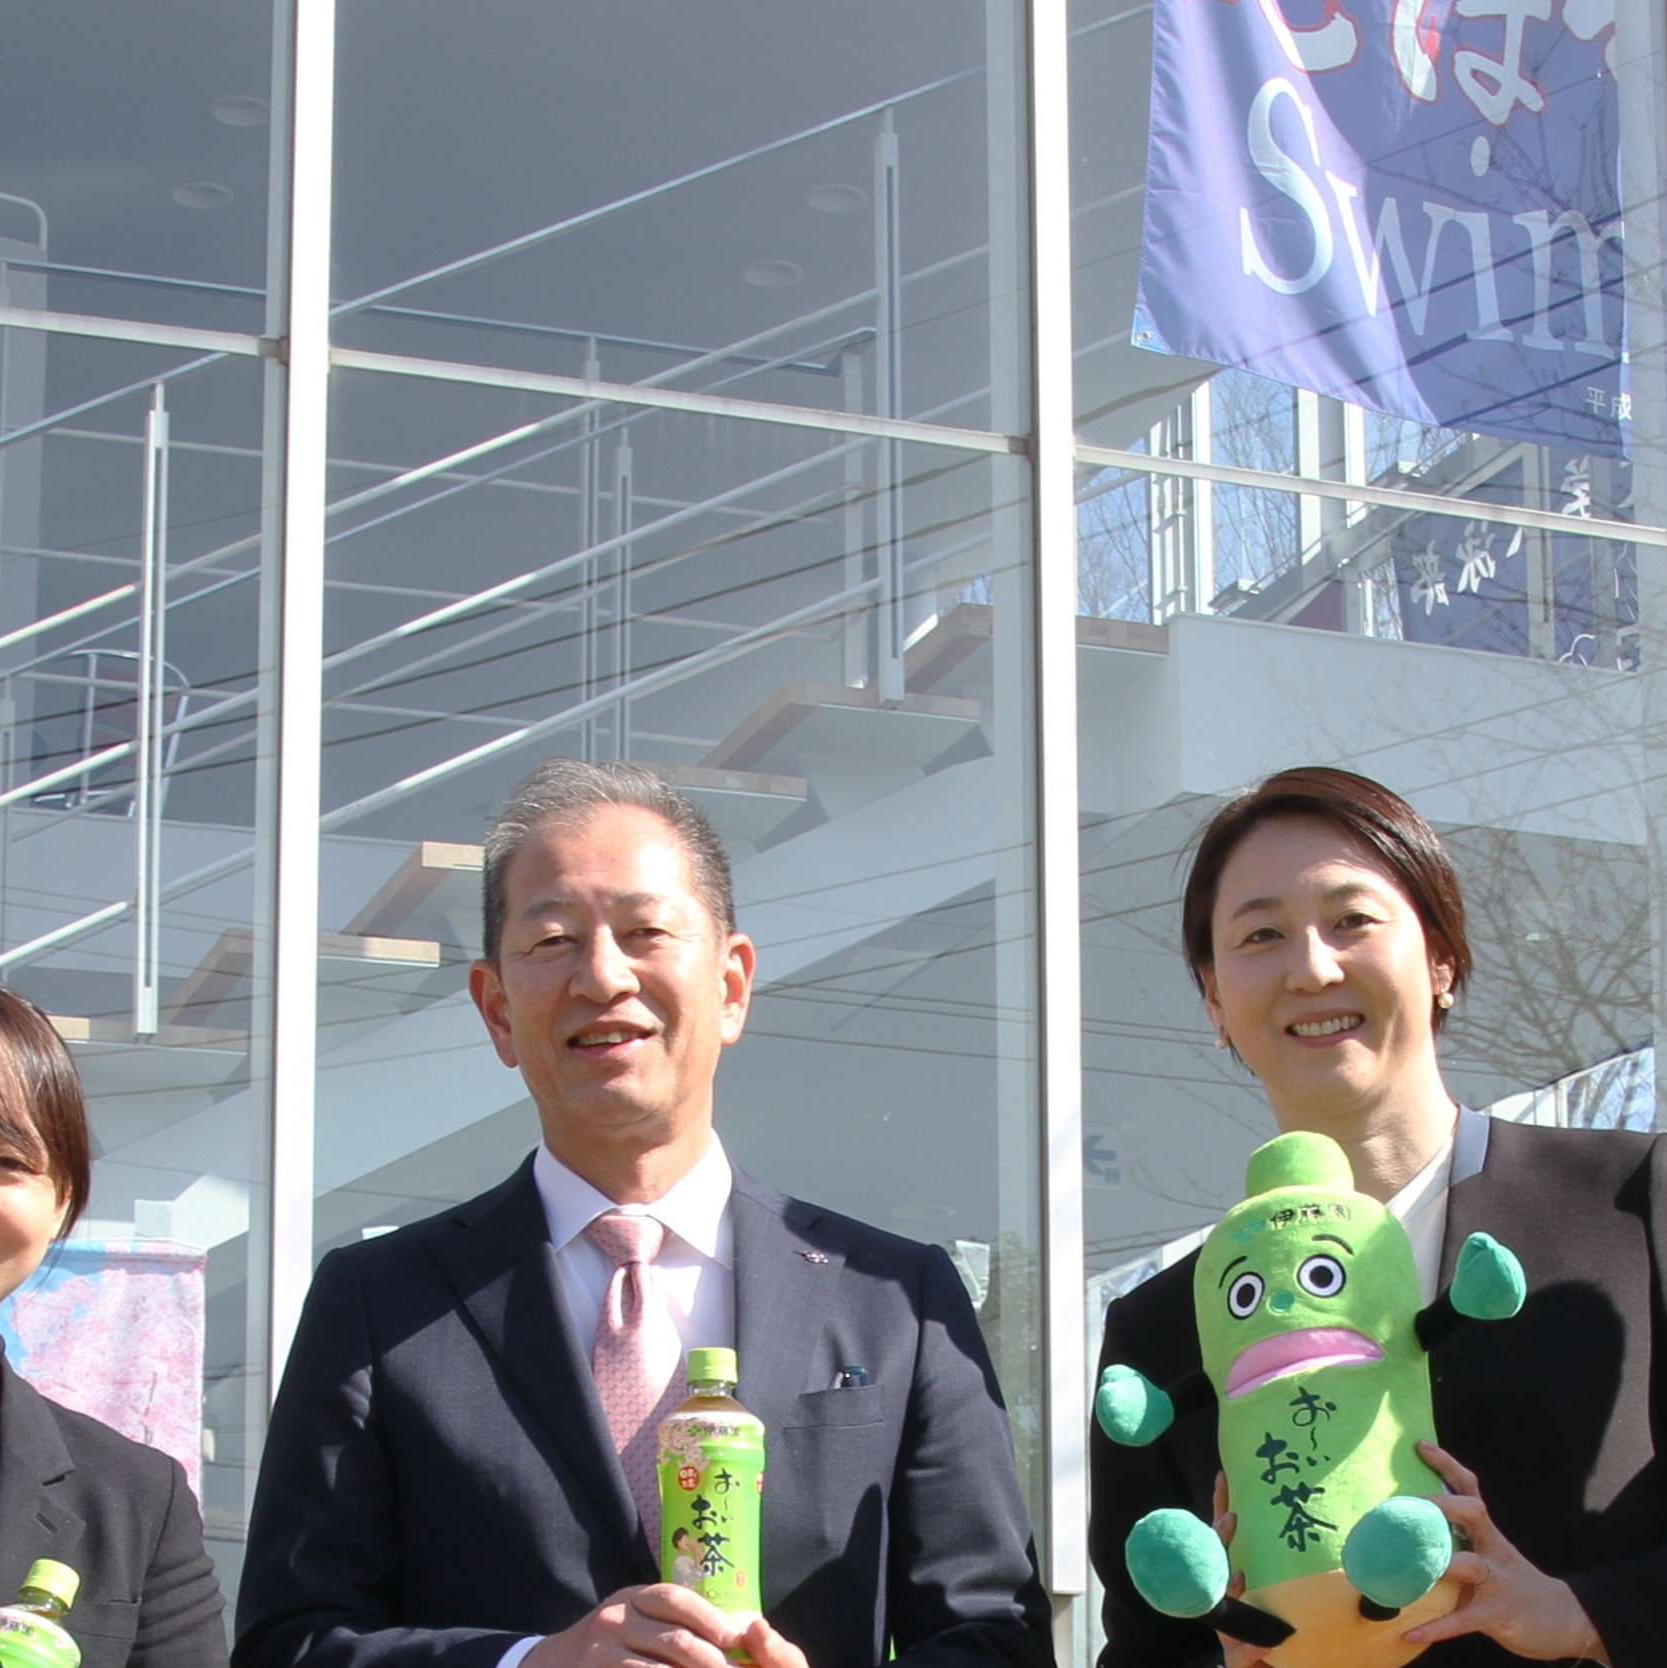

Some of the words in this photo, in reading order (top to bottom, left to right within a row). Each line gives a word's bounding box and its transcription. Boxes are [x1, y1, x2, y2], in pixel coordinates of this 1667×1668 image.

[1239, 77, 1629, 363] Swim
[1269, 1204, 1352, 1231] 伊藤園
[691, 1494, 735, 1577] お茶
[1256, 1432, 1338, 1552] お茶
